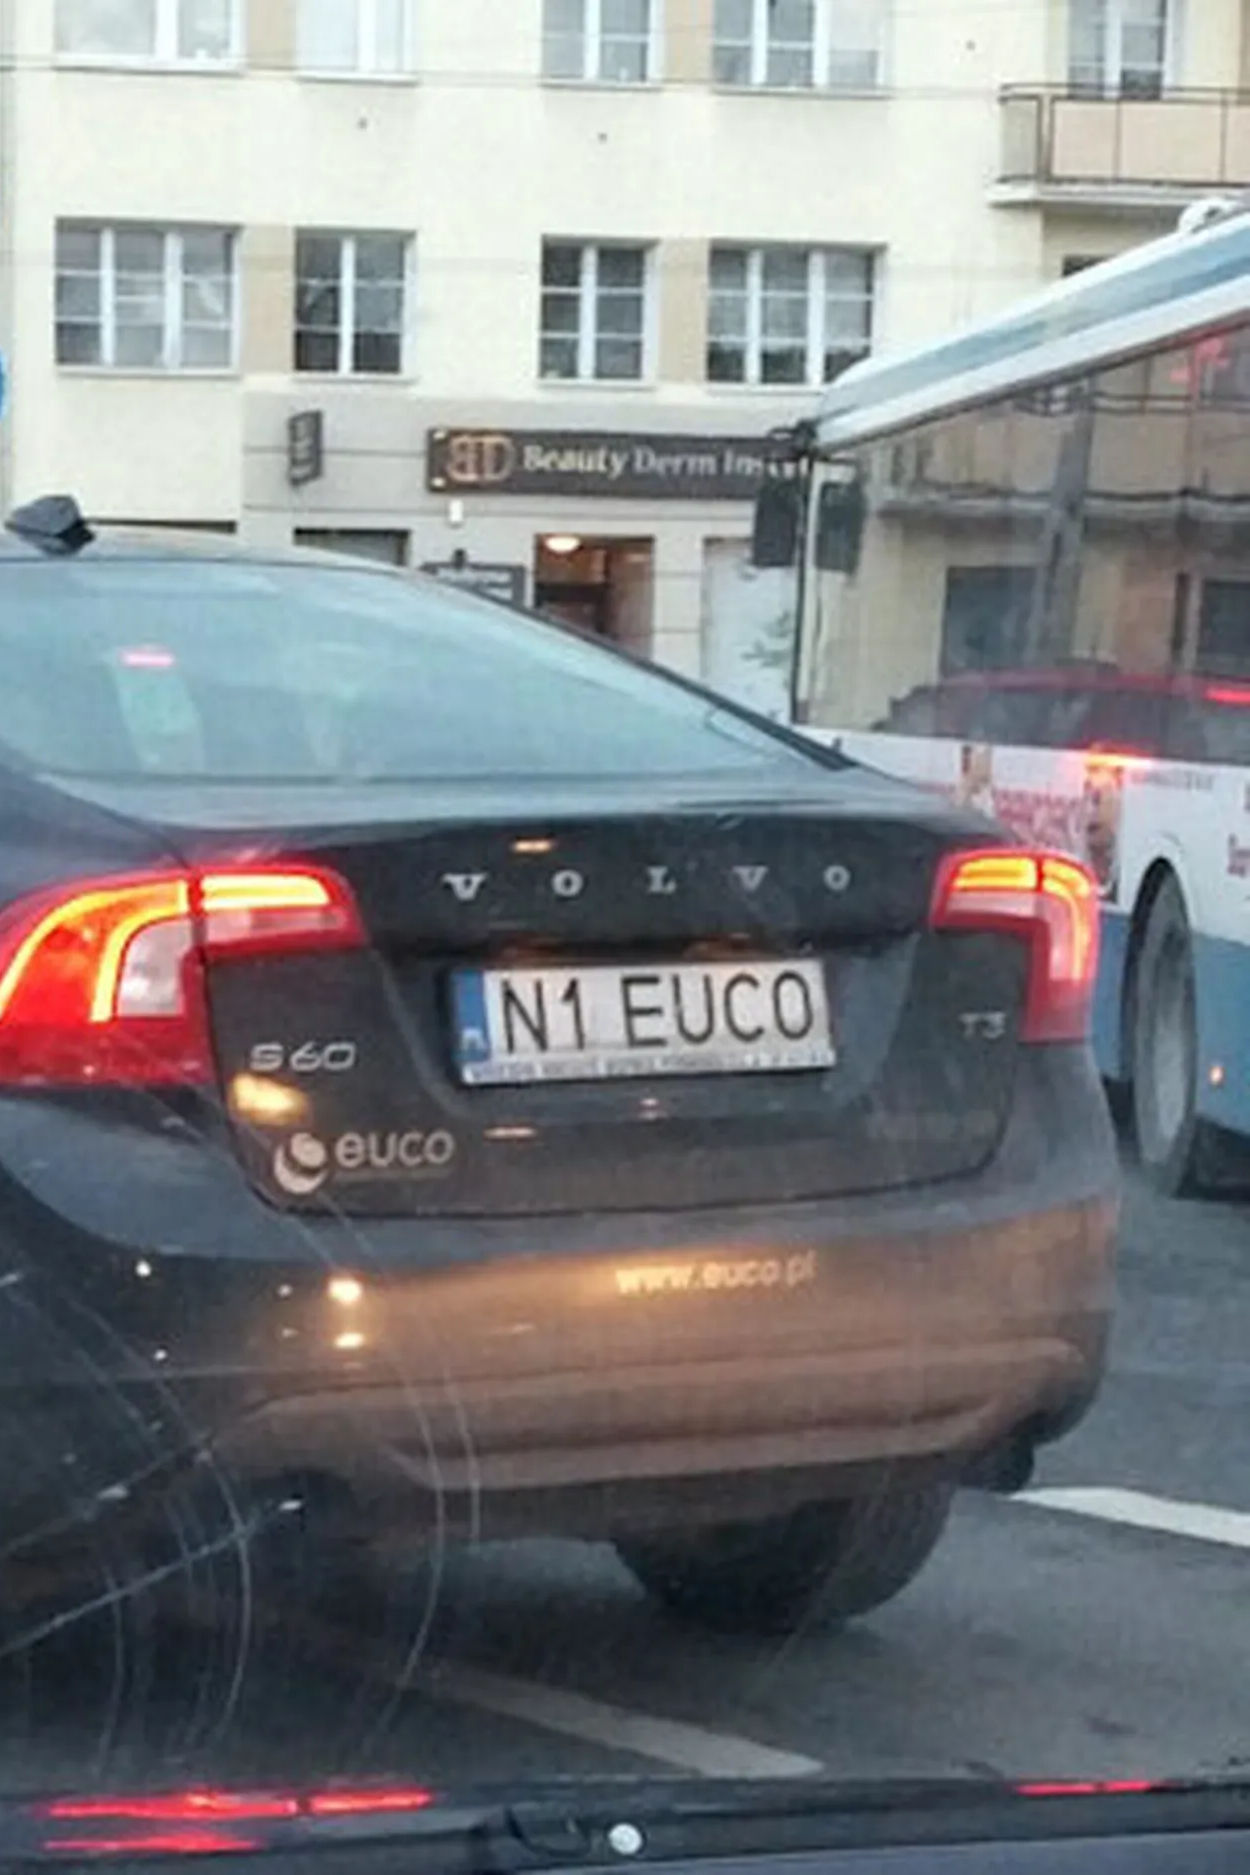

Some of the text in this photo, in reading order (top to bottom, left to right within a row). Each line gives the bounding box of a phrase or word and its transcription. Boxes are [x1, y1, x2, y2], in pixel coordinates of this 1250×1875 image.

[522, 443, 632, 480] Beauty
[633, 445, 718, 477] Derm
[442, 864, 851, 901] VOLVO
[500, 970, 814, 1053] N1 EUCO
[250, 1040, 357, 1072] S60
[334, 1127, 455, 1168] euco
